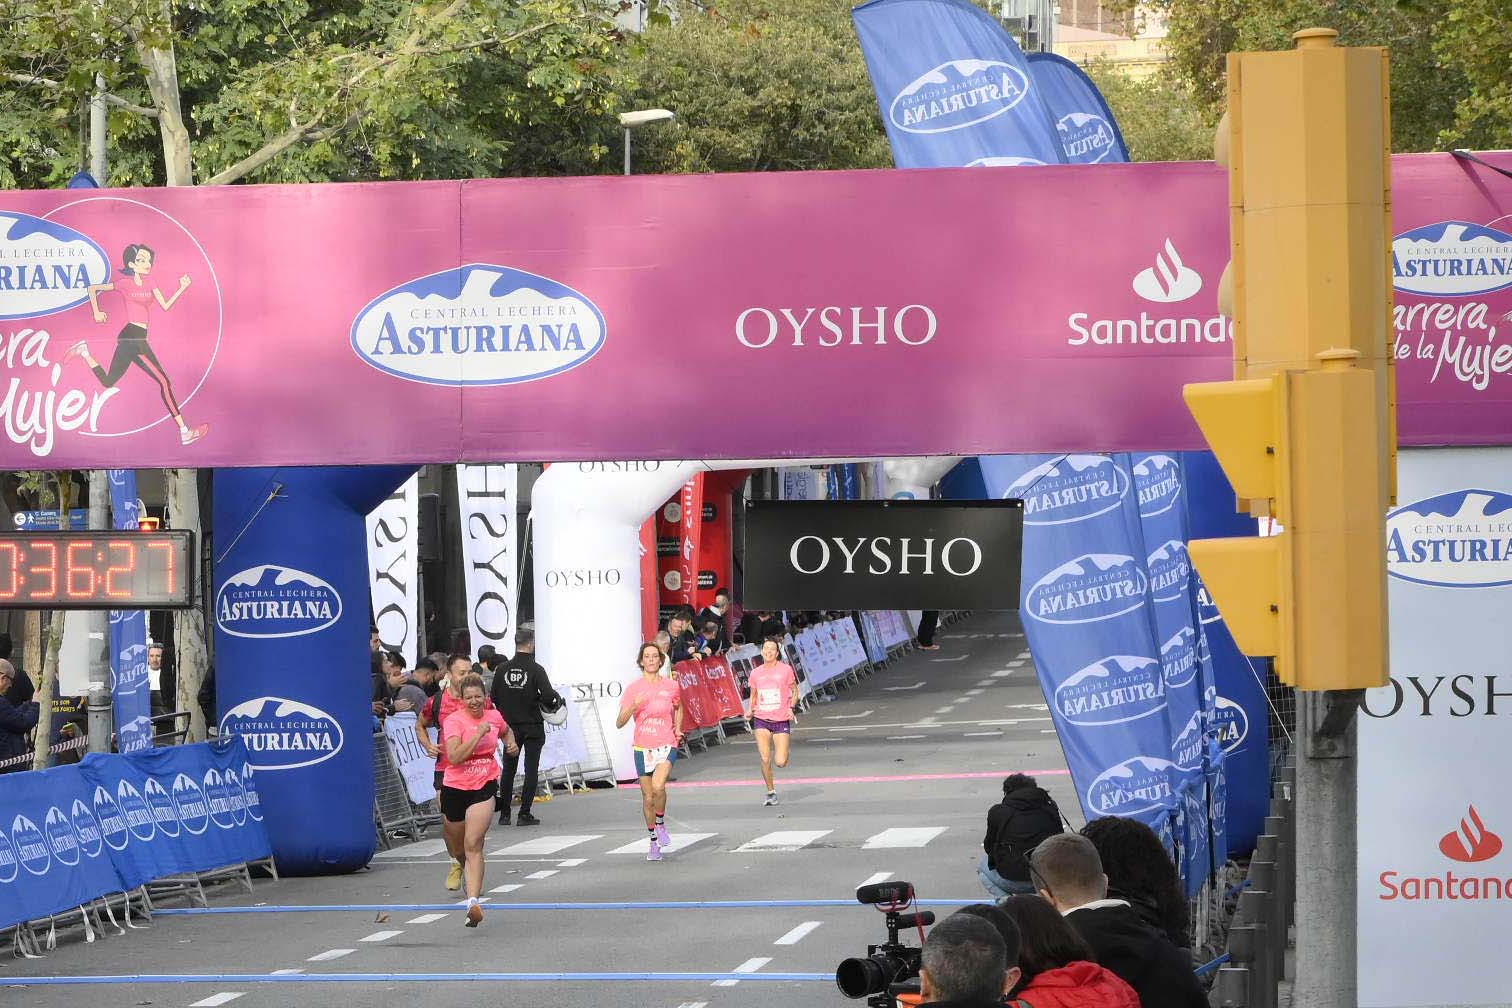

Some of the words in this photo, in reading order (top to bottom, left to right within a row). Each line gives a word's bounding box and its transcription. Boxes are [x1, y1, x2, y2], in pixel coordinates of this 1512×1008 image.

[13, 247, 86, 258] LECHERA
[410, 307, 488, 319] CENTRAL
[497, 305, 577, 316] LECHERA
[1393, 302, 1488, 331] arrera
[371, 311, 586, 355] ASTURIANA
[735, 304, 937, 348] OYSHO
[1416, 332, 1435, 359] la
[1414, 523, 1481, 534] CENTRAL
[790, 536, 982, 576] OYSHO
[545, 568, 621, 589] OYSHO
[232, 590, 275, 599] CENTRAL
[279, 589, 328, 598] LECHERA
[219, 595, 333, 622] ASTURIANA
[510, 673, 522, 683] BP
[234, 722, 276, 731] CENTRAL
[280, 721, 329, 730] LECHERA
